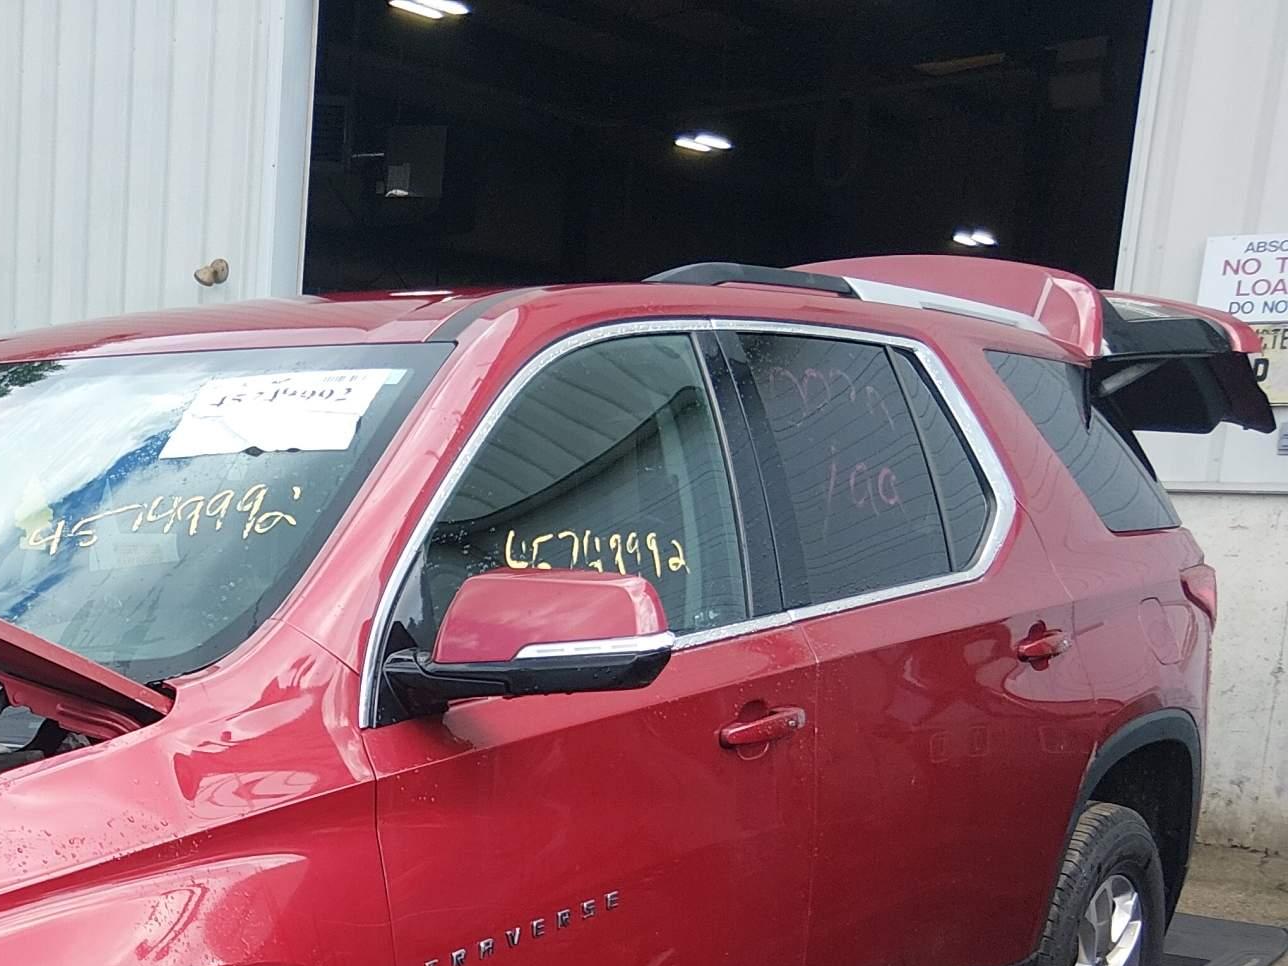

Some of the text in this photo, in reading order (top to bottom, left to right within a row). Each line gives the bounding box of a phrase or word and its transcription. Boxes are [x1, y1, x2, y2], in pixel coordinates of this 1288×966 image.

[1222, 258, 1262, 276] NO
[1235, 278, 1288, 297] LOA
[1229, 300, 1255, 315] DO
